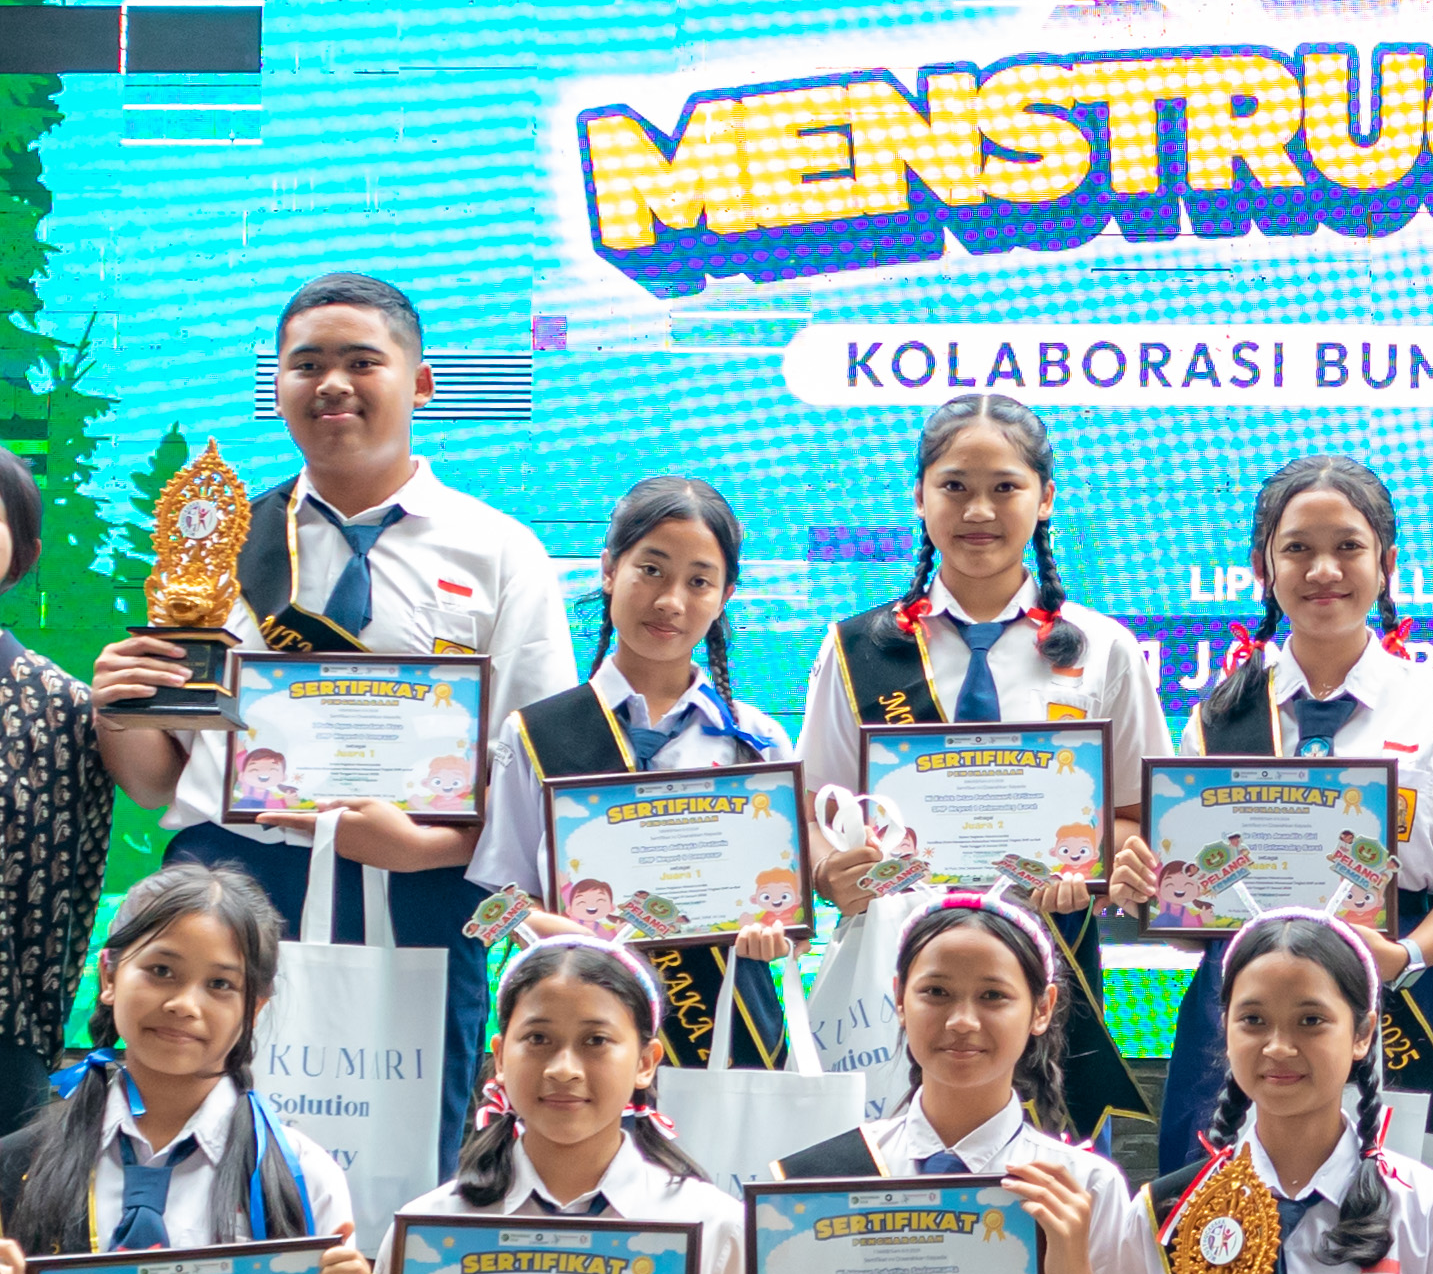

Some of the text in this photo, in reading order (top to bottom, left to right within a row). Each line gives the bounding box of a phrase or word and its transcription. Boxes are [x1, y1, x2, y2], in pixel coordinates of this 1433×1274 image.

[844, 340, 1286, 390] KOLABORASI
[289, 680, 432, 701] SERTIFIKAT
[915, 749, 1054, 772] SERTIFIKAT
[607, 796, 748, 824] SERTIFIKAT
[1201, 785, 1341, 808] SERTIFIKAT
[1333, 850, 1382, 886] PELANGI
[814, 1210, 979, 1241] SERTIFIKAT
